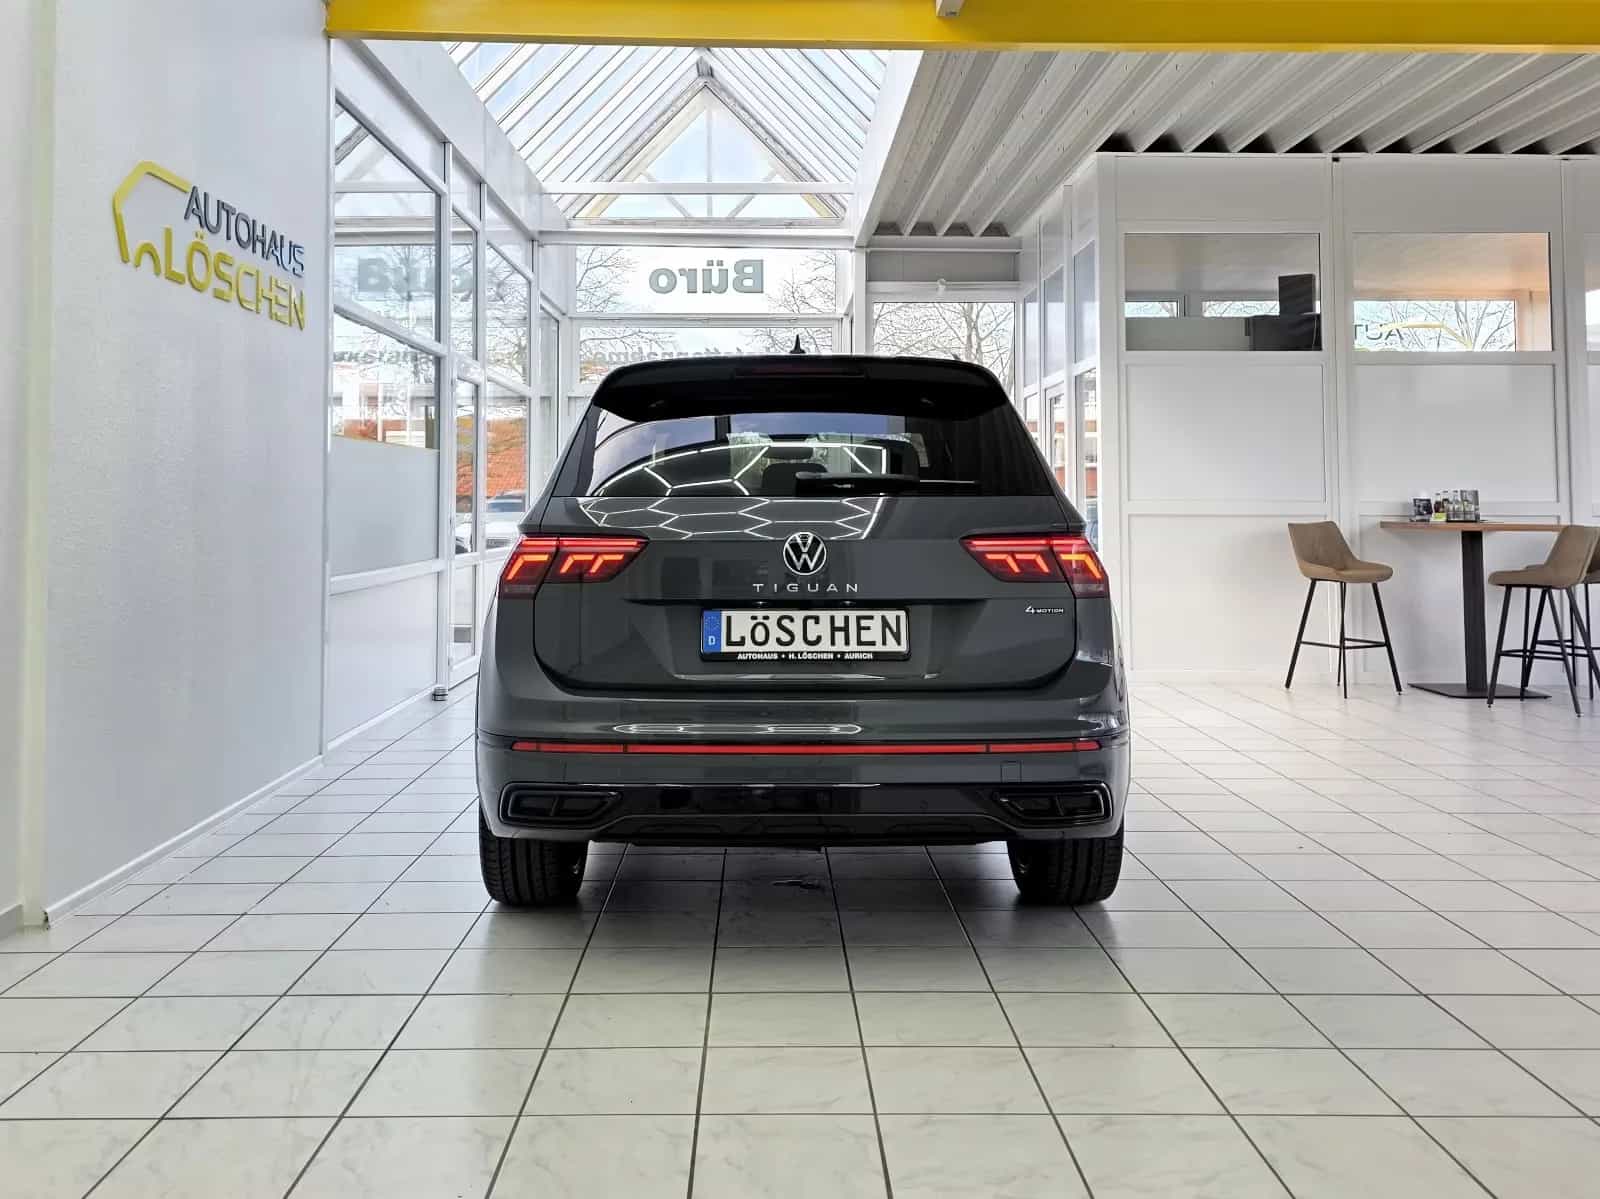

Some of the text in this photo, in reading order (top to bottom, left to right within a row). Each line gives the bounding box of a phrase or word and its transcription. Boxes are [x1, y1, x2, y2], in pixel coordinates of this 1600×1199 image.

[183, 185, 305, 278] AUTOHAUS
[164, 227, 305, 331] LÖSCHEN
[752, 583, 859, 593] TIGUAN
[708, 615, 902, 647] D LÖSCHEN
[737, 652, 779, 660] AUTOHAUS
[797, 651, 834, 660] LÖSCHEN
[844, 652, 873, 660] AURICH
